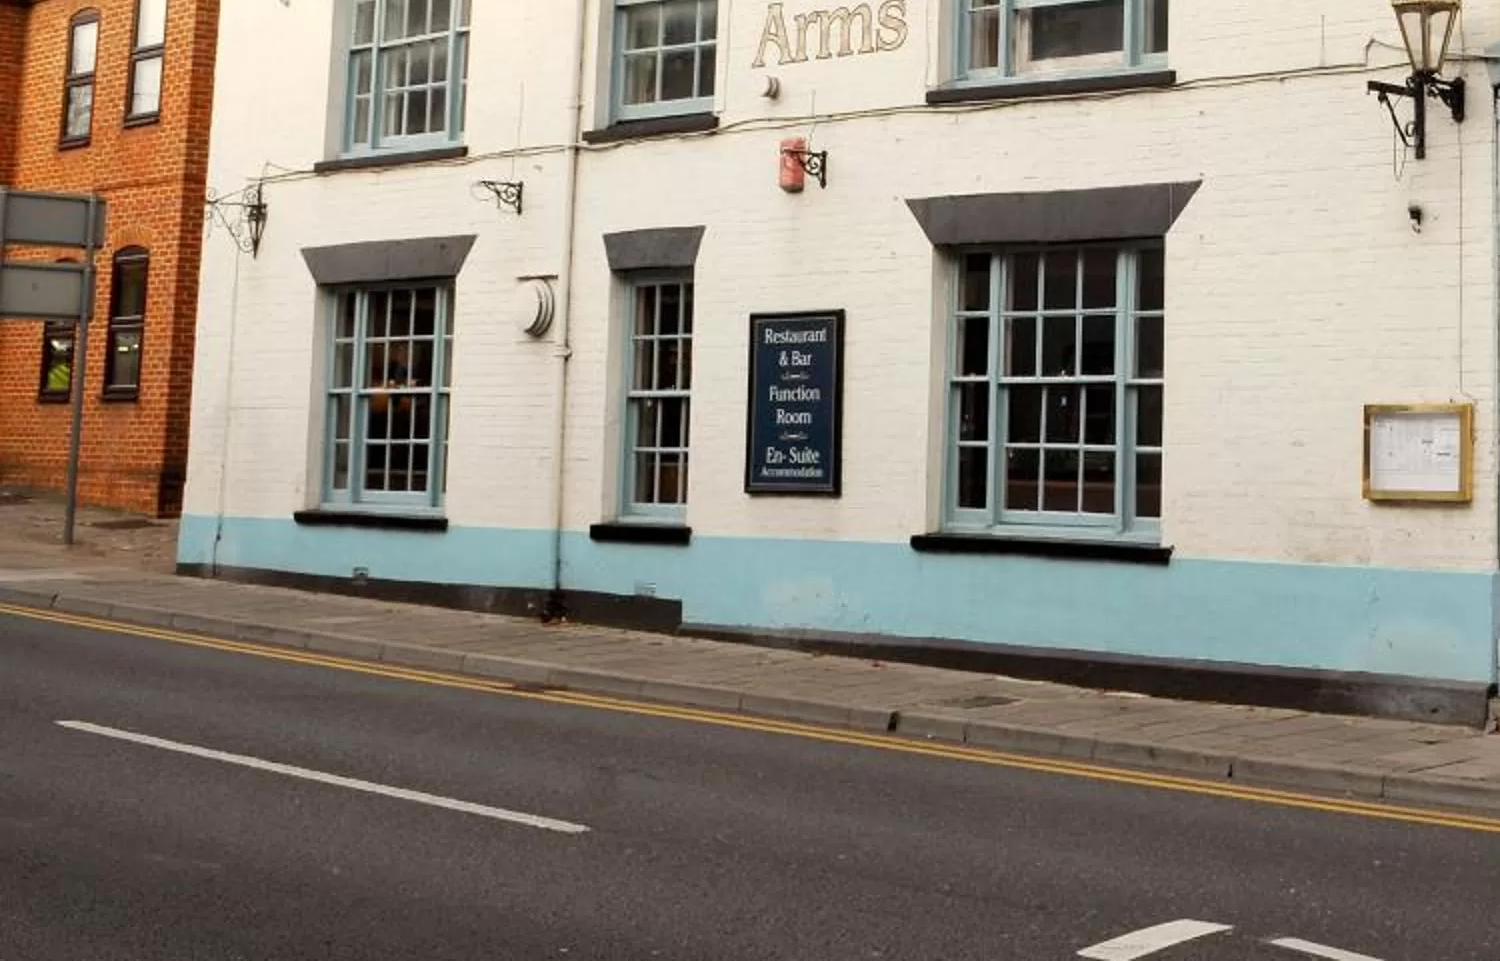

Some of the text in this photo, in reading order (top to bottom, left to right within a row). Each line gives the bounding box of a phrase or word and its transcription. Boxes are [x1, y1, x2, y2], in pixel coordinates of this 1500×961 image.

[764, 327, 827, 345] Restaurant
[778, 350, 812, 366] & Bar
[769, 384, 821, 402] Function
[776, 408, 812, 425] Room
[789, 446, 820, 464] Suite
